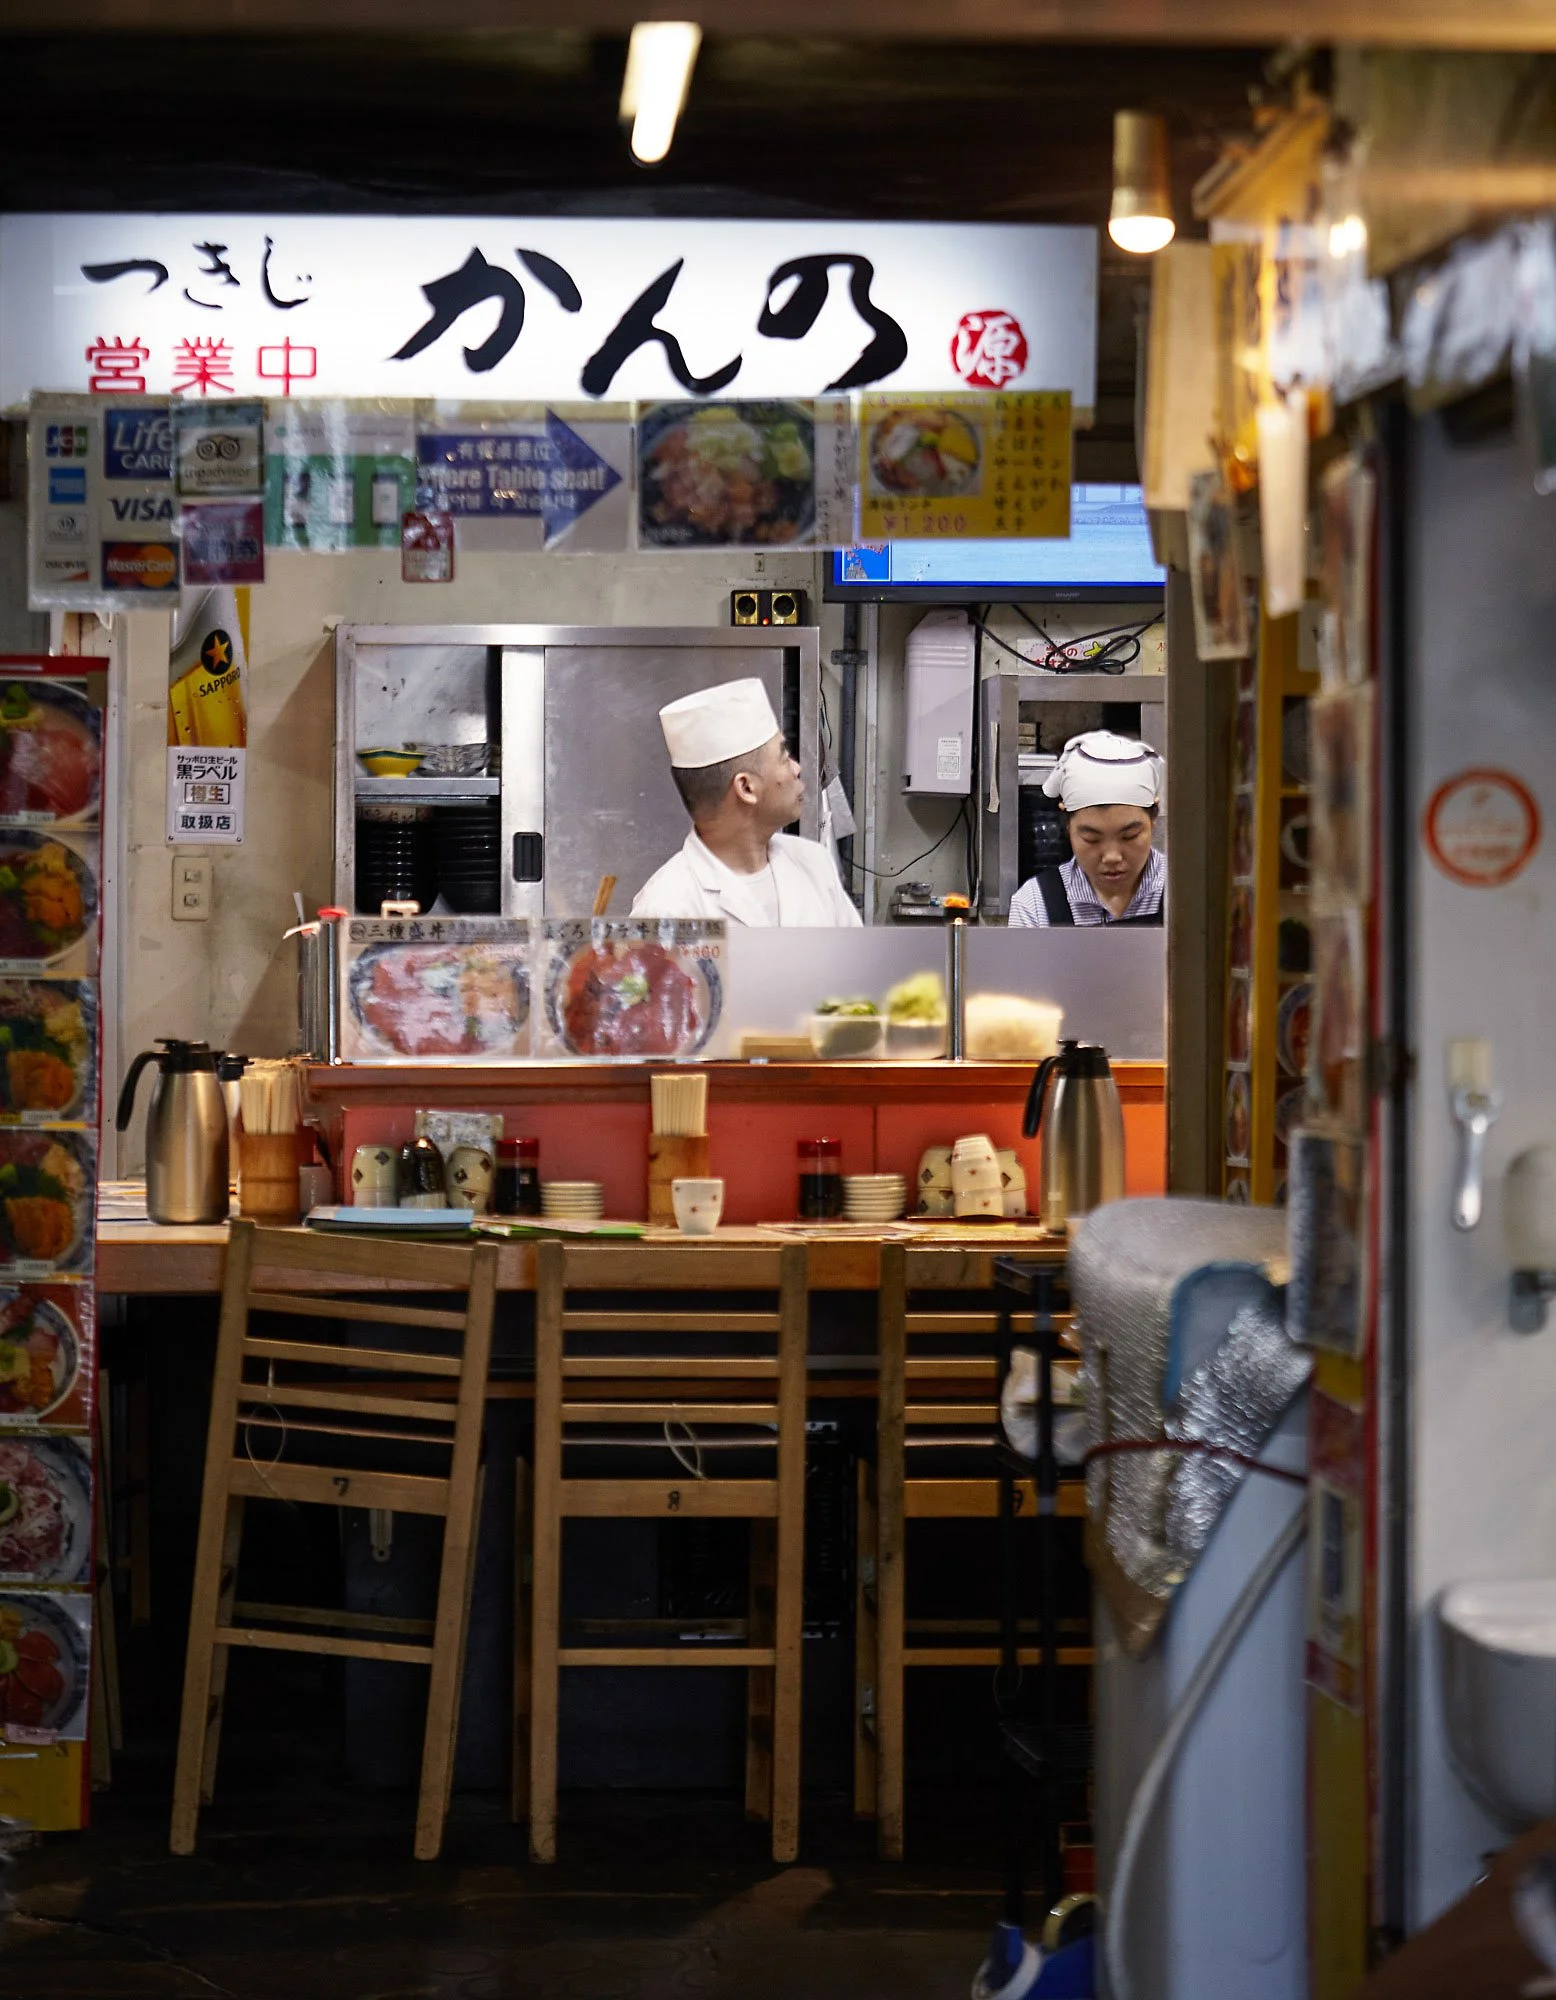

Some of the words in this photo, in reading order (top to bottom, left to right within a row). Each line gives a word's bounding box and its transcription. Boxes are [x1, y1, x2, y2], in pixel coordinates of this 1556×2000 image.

[80, 234, 313, 309] つきじ
[385, 246, 908, 396] かんの
[954, 312, 1023, 387] 源
[85, 335, 318, 396] 営業中
[487, 464, 547, 489] Table
[110, 498, 173, 521] VISA
[106, 558, 176, 573] MasterCard
[199, 666, 241, 698] SAPPORO
[176, 755, 238, 765] サッポロ生ビール
[176, 765, 238, 781] 黒ラベル
[180, 815, 231, 830] 取扱店
[331, 1476, 350, 1497] 7
[667, 1489, 681, 1512] 8
